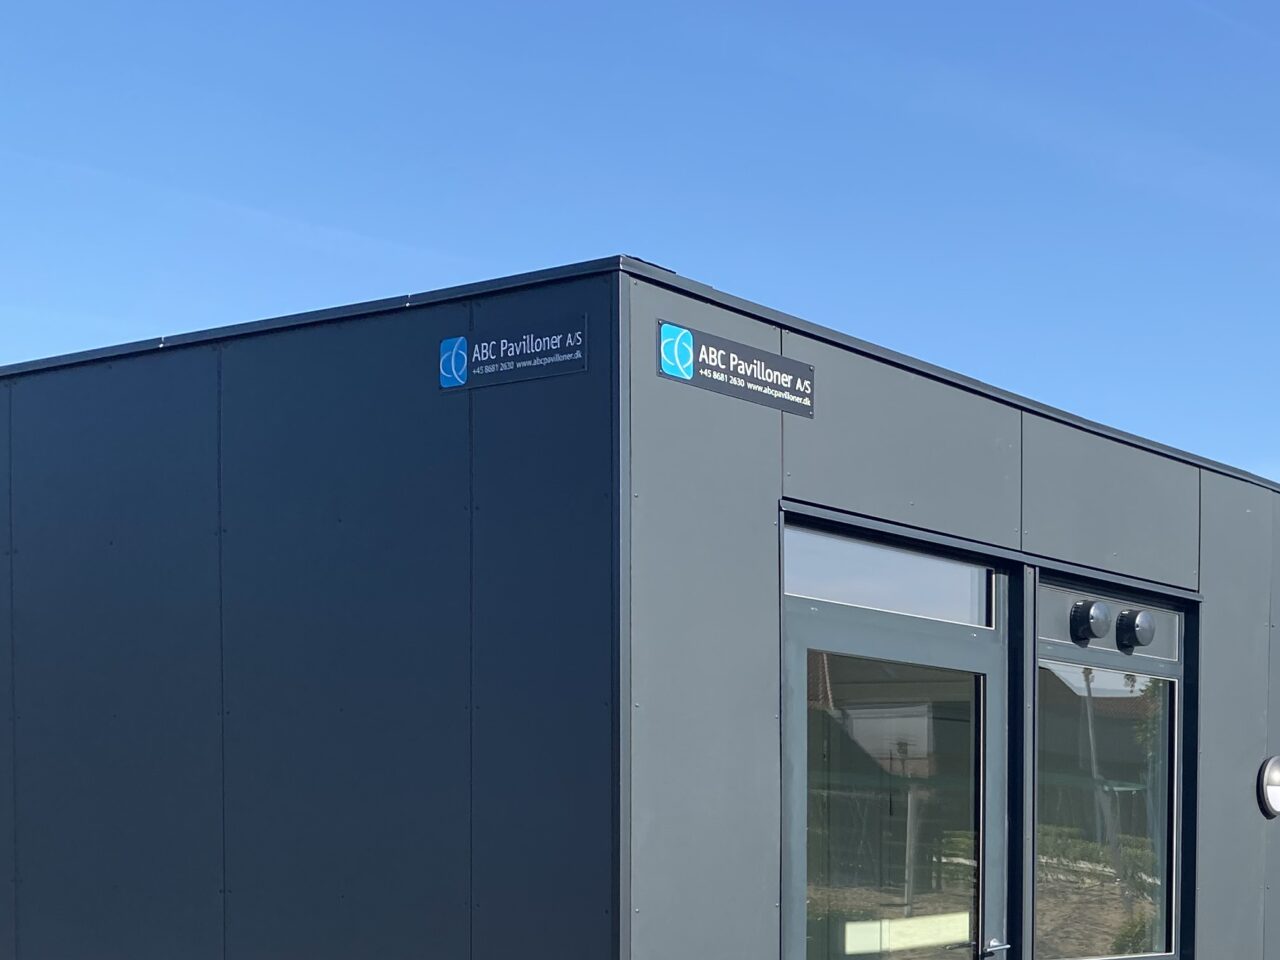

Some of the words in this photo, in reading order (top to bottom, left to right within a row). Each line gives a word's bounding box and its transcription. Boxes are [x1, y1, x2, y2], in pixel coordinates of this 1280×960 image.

[472, 341, 497, 362] ABC
[500, 333, 563, 357] Pavilloner
[566, 332, 582, 347] A/S
[699, 345, 726, 369] ABC
[729, 353, 793, 388] Pavilloner
[796, 378, 812, 394] A/S
[699, 368, 712, 378] +45
[712, 371, 728, 382] 8681
